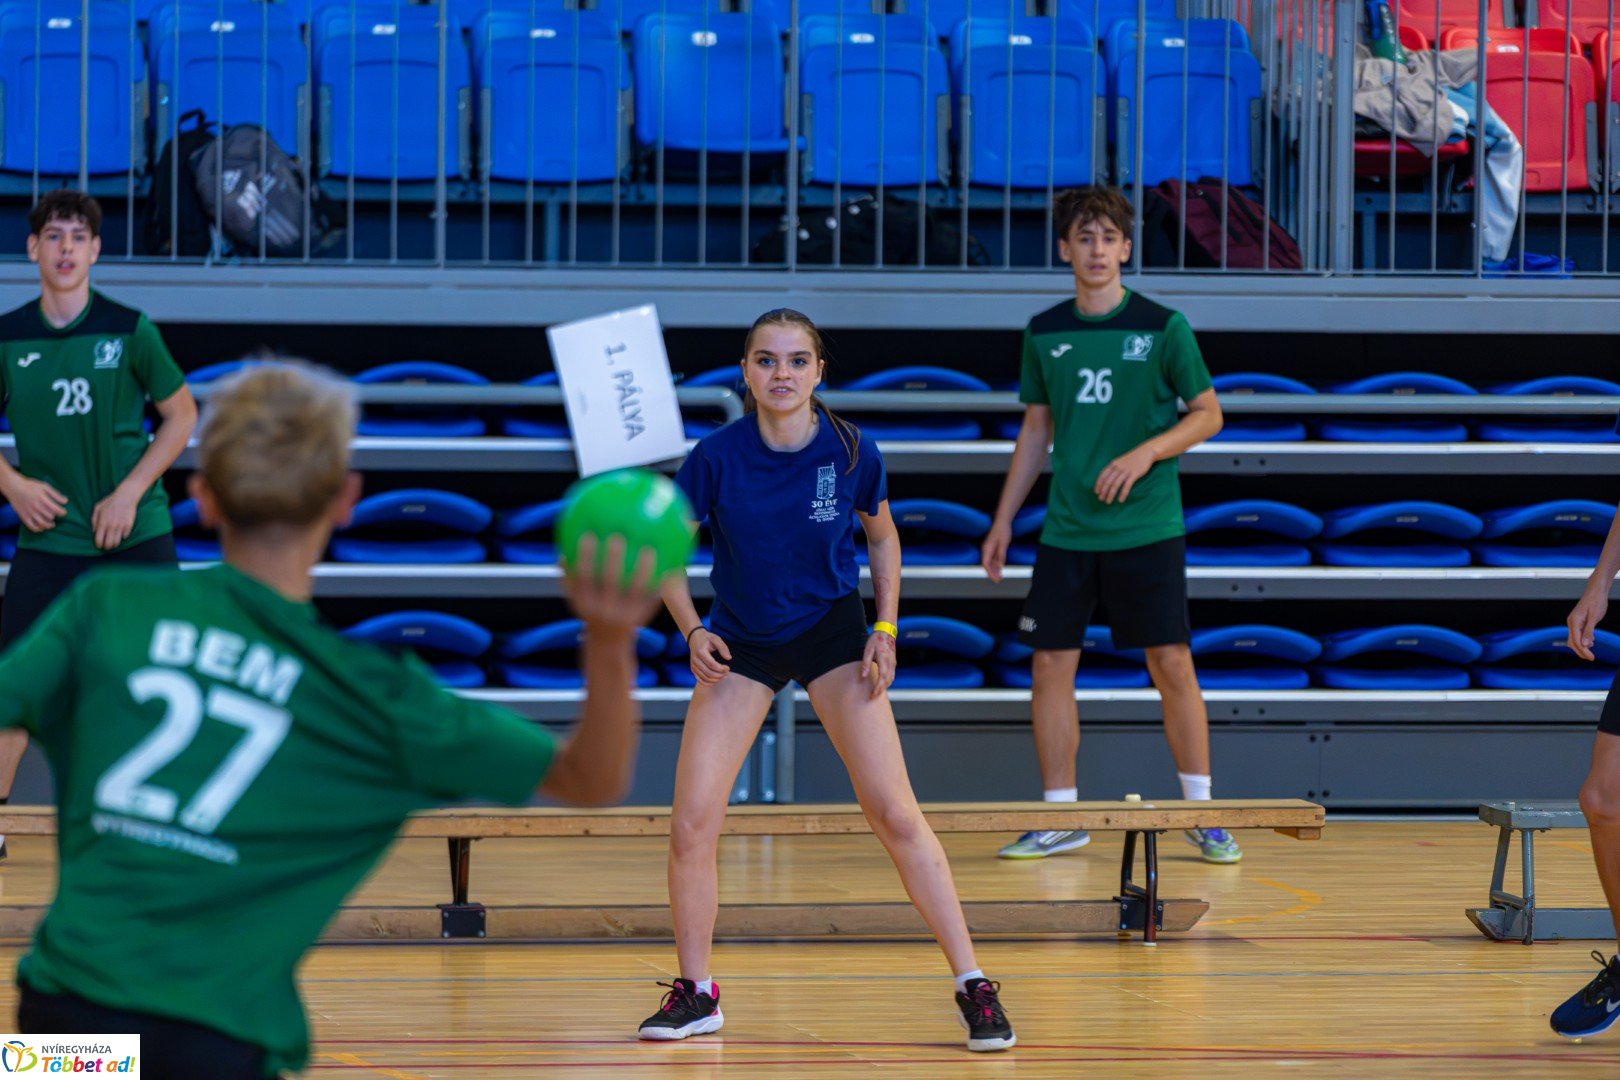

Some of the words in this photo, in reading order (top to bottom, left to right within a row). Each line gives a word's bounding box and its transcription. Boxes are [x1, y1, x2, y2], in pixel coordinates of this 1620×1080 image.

[604, 341, 627, 366] 1.
[51, 376, 94, 417] 28
[610, 368, 646, 442] PÁLYA
[1075, 366, 1114, 405] 26
[811, 500, 824, 508] 30
[149, 617, 305, 706] BEM
[94, 664, 294, 835] 27
